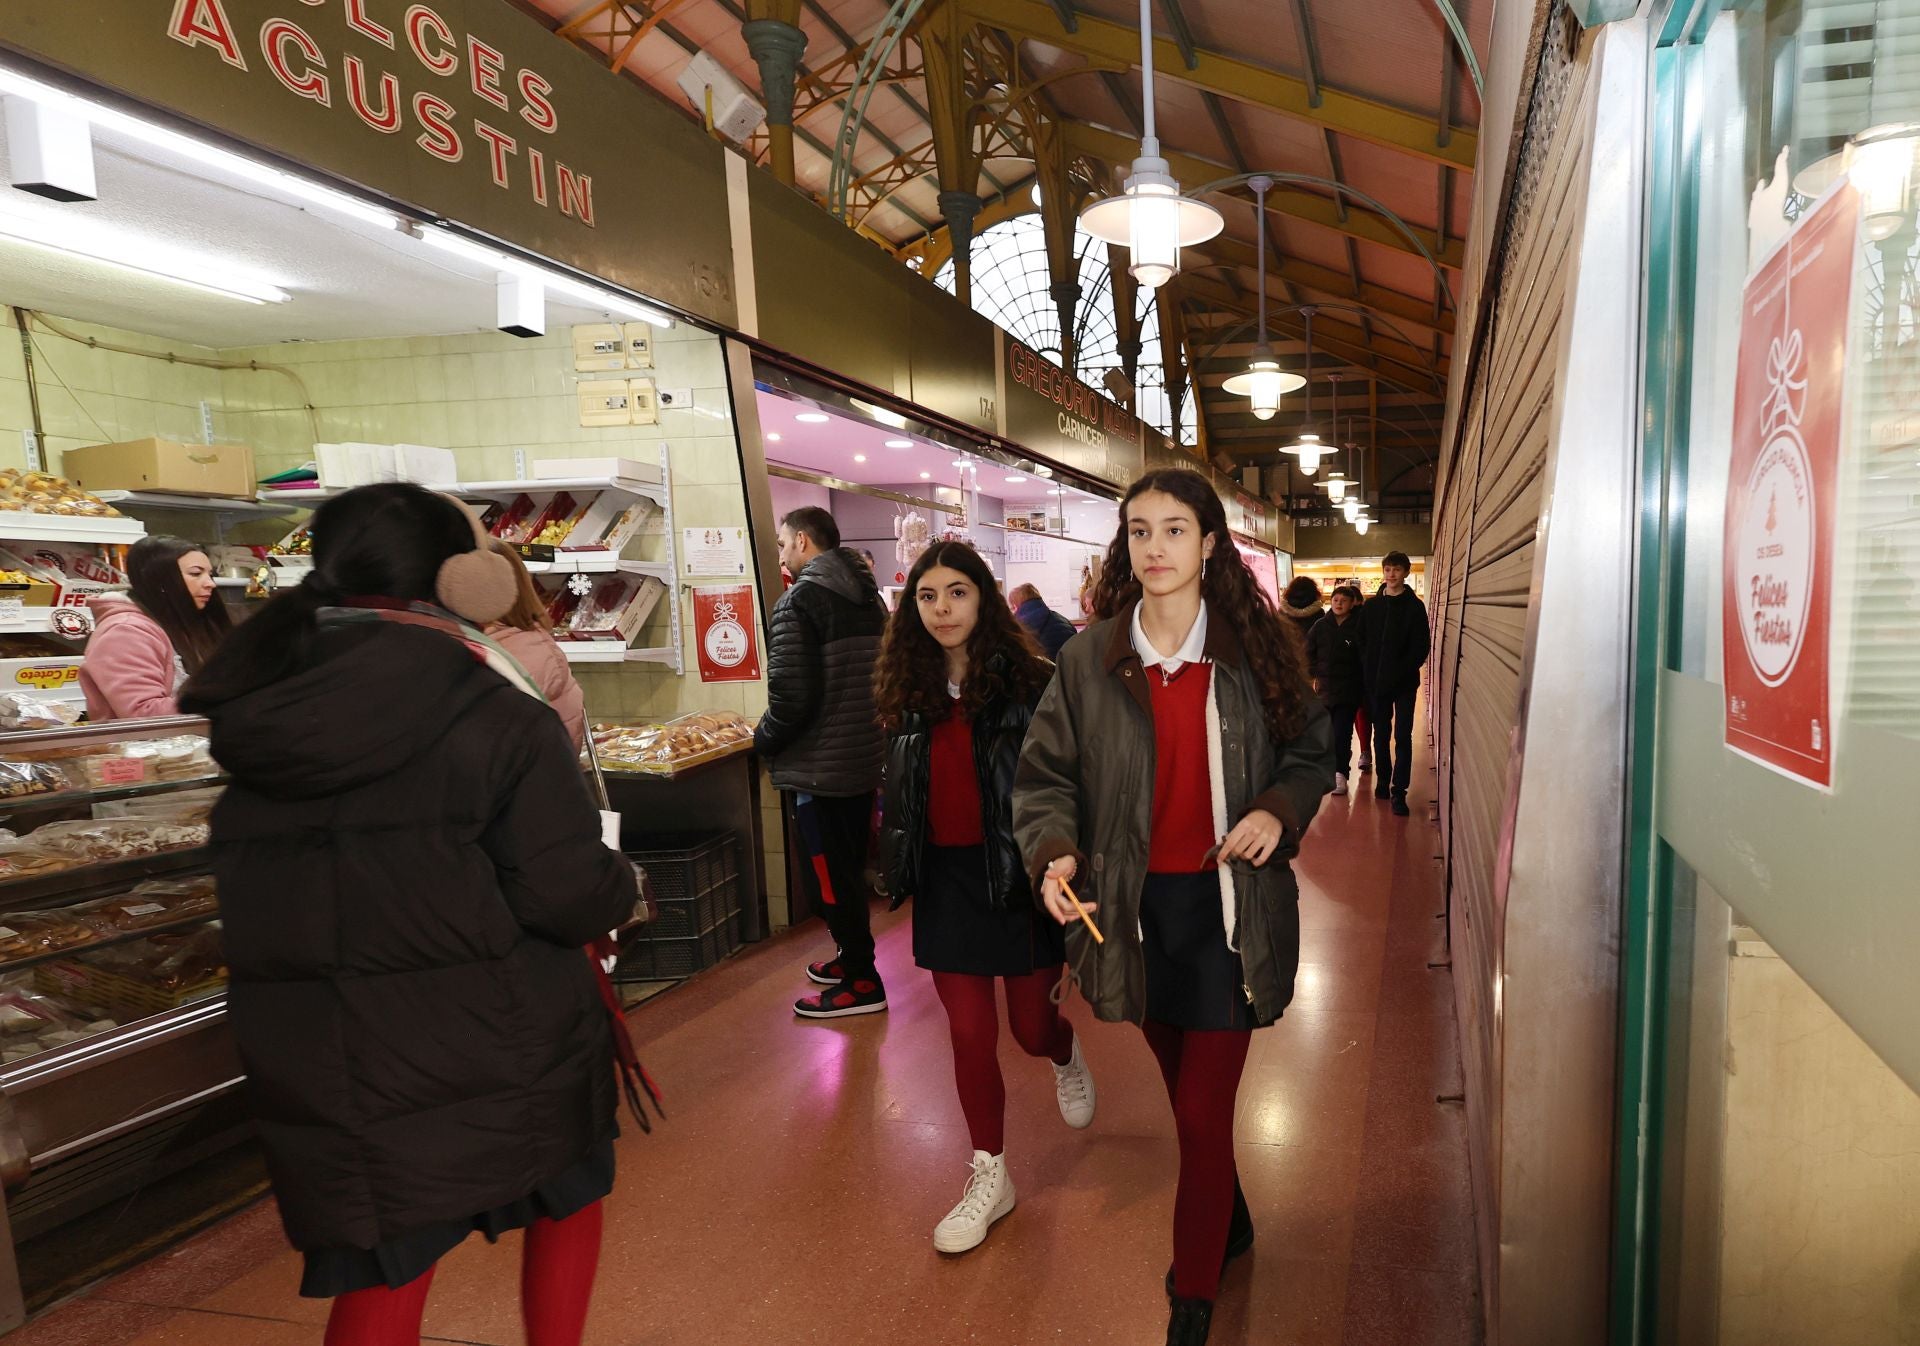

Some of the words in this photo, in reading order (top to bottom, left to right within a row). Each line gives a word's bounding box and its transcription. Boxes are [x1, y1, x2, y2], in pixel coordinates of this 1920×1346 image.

[299, 0, 557, 135] LCES
[166, 0, 596, 229] AGUSTIN
[1009, 342, 1099, 425] GREGORIO
[1057, 411, 1111, 457] CARNICERIA
[1751, 573, 1788, 609] Felices
[1754, 610, 1792, 647] Fiestas
[716, 645, 737, 653] Felices
[717, 652, 740, 660] Fiestas
[20, 669, 62, 680] Cateto
